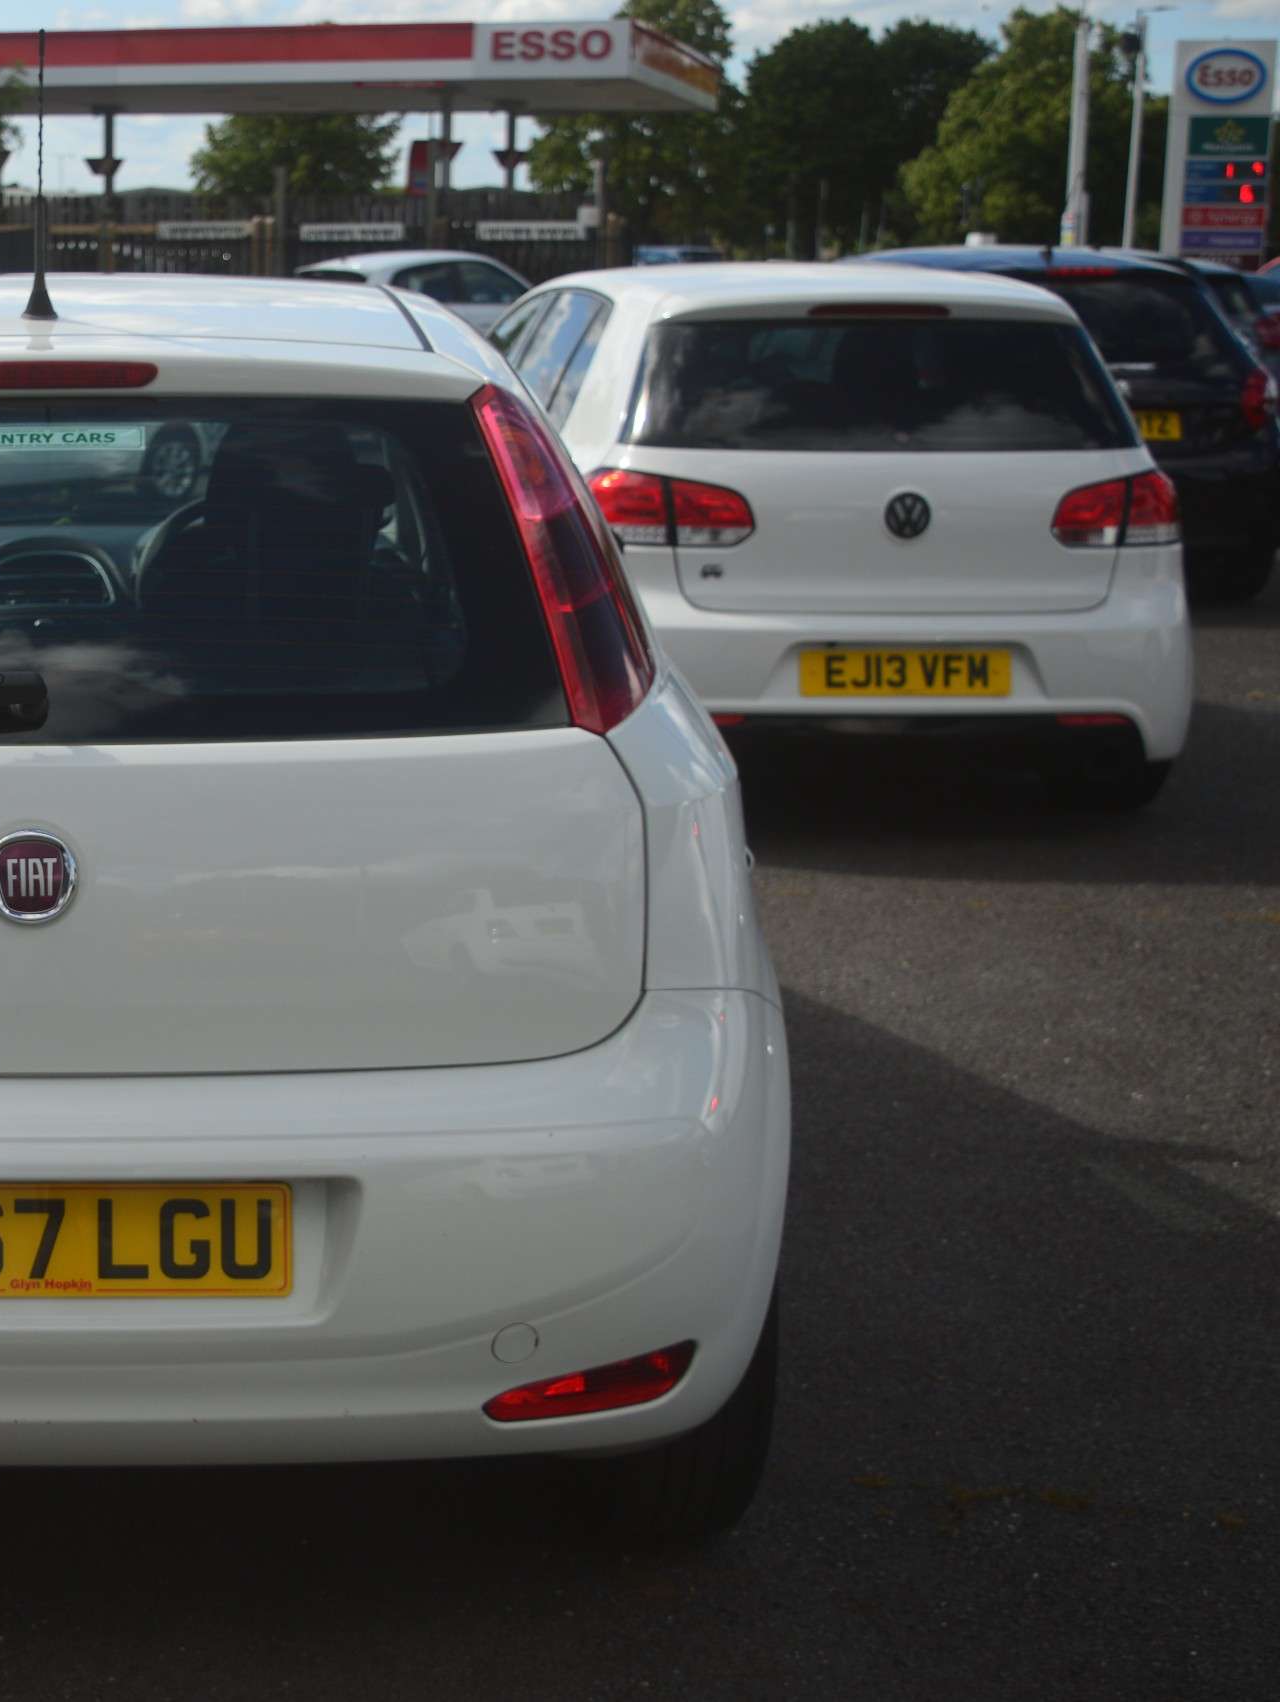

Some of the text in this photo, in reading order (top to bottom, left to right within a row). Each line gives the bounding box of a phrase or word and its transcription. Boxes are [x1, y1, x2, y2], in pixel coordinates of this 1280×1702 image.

[491, 29, 614, 62] ESSO
[1198, 62, 1256, 88] Esso
[62, 432, 116, 444] CARS
[825, 654, 990, 689] EJ13 VFM
[6, 857, 57, 897] FIAT
[97, 1198, 272, 1280] LGU
[10, 1278, 93, 1294] Glyn Hopkin
